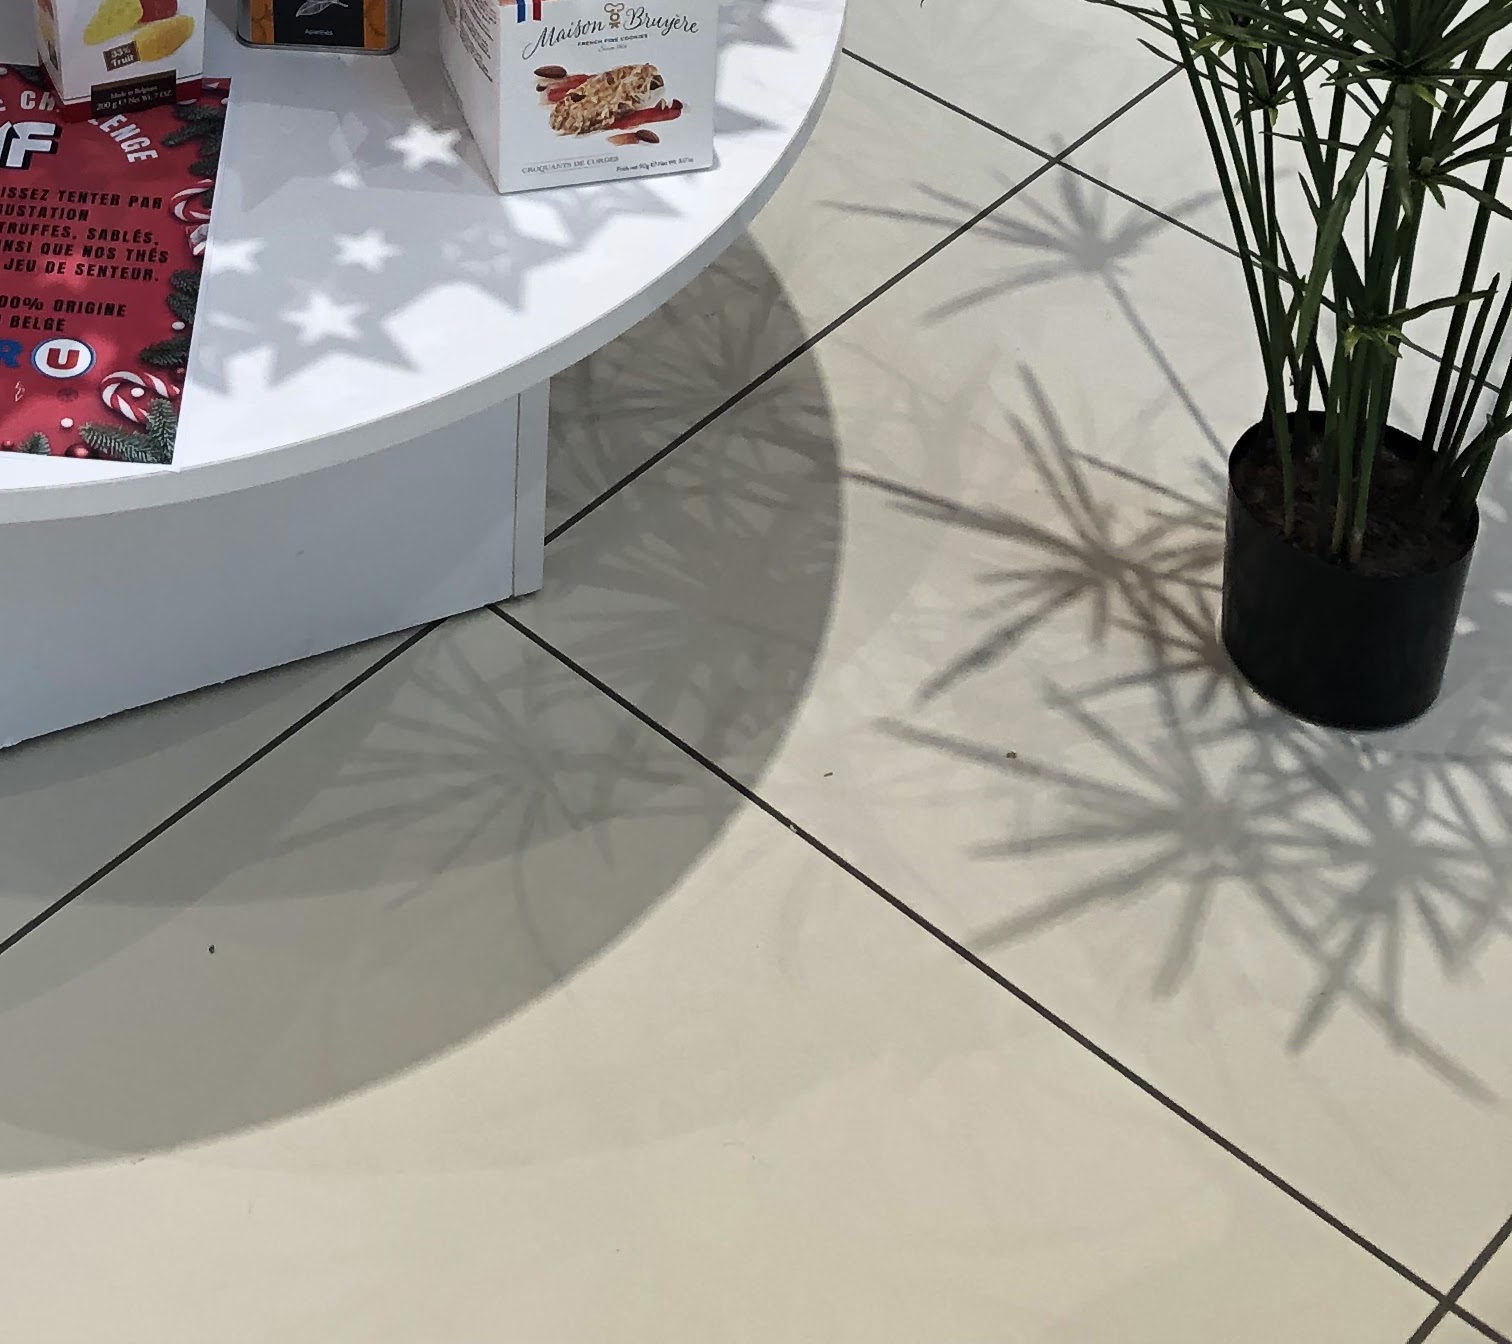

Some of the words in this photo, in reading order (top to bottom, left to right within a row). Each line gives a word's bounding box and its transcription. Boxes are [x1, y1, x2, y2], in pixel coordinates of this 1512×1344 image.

[522, 17, 607, 60] Maison
[623, 6, 700, 36] Bruyère
[111, 45, 131, 59] 33%
[111, 54, 135, 67] Fruit
[58, 189, 120, 207] TENTER
[128, 195, 163, 210] PAR
[41, 242, 74, 257] QUE
[82, 245, 116, 260] NOS
[125, 244, 169, 264] THÉS
[4, 258, 37, 273] JEU
[45, 261, 66, 275] DE
[75, 263, 160, 282] SENTEUR.
[53, 298, 127, 318] ORIGINE
[9, 315, 67, 332] BELGE
[46, 347, 81, 370] U
